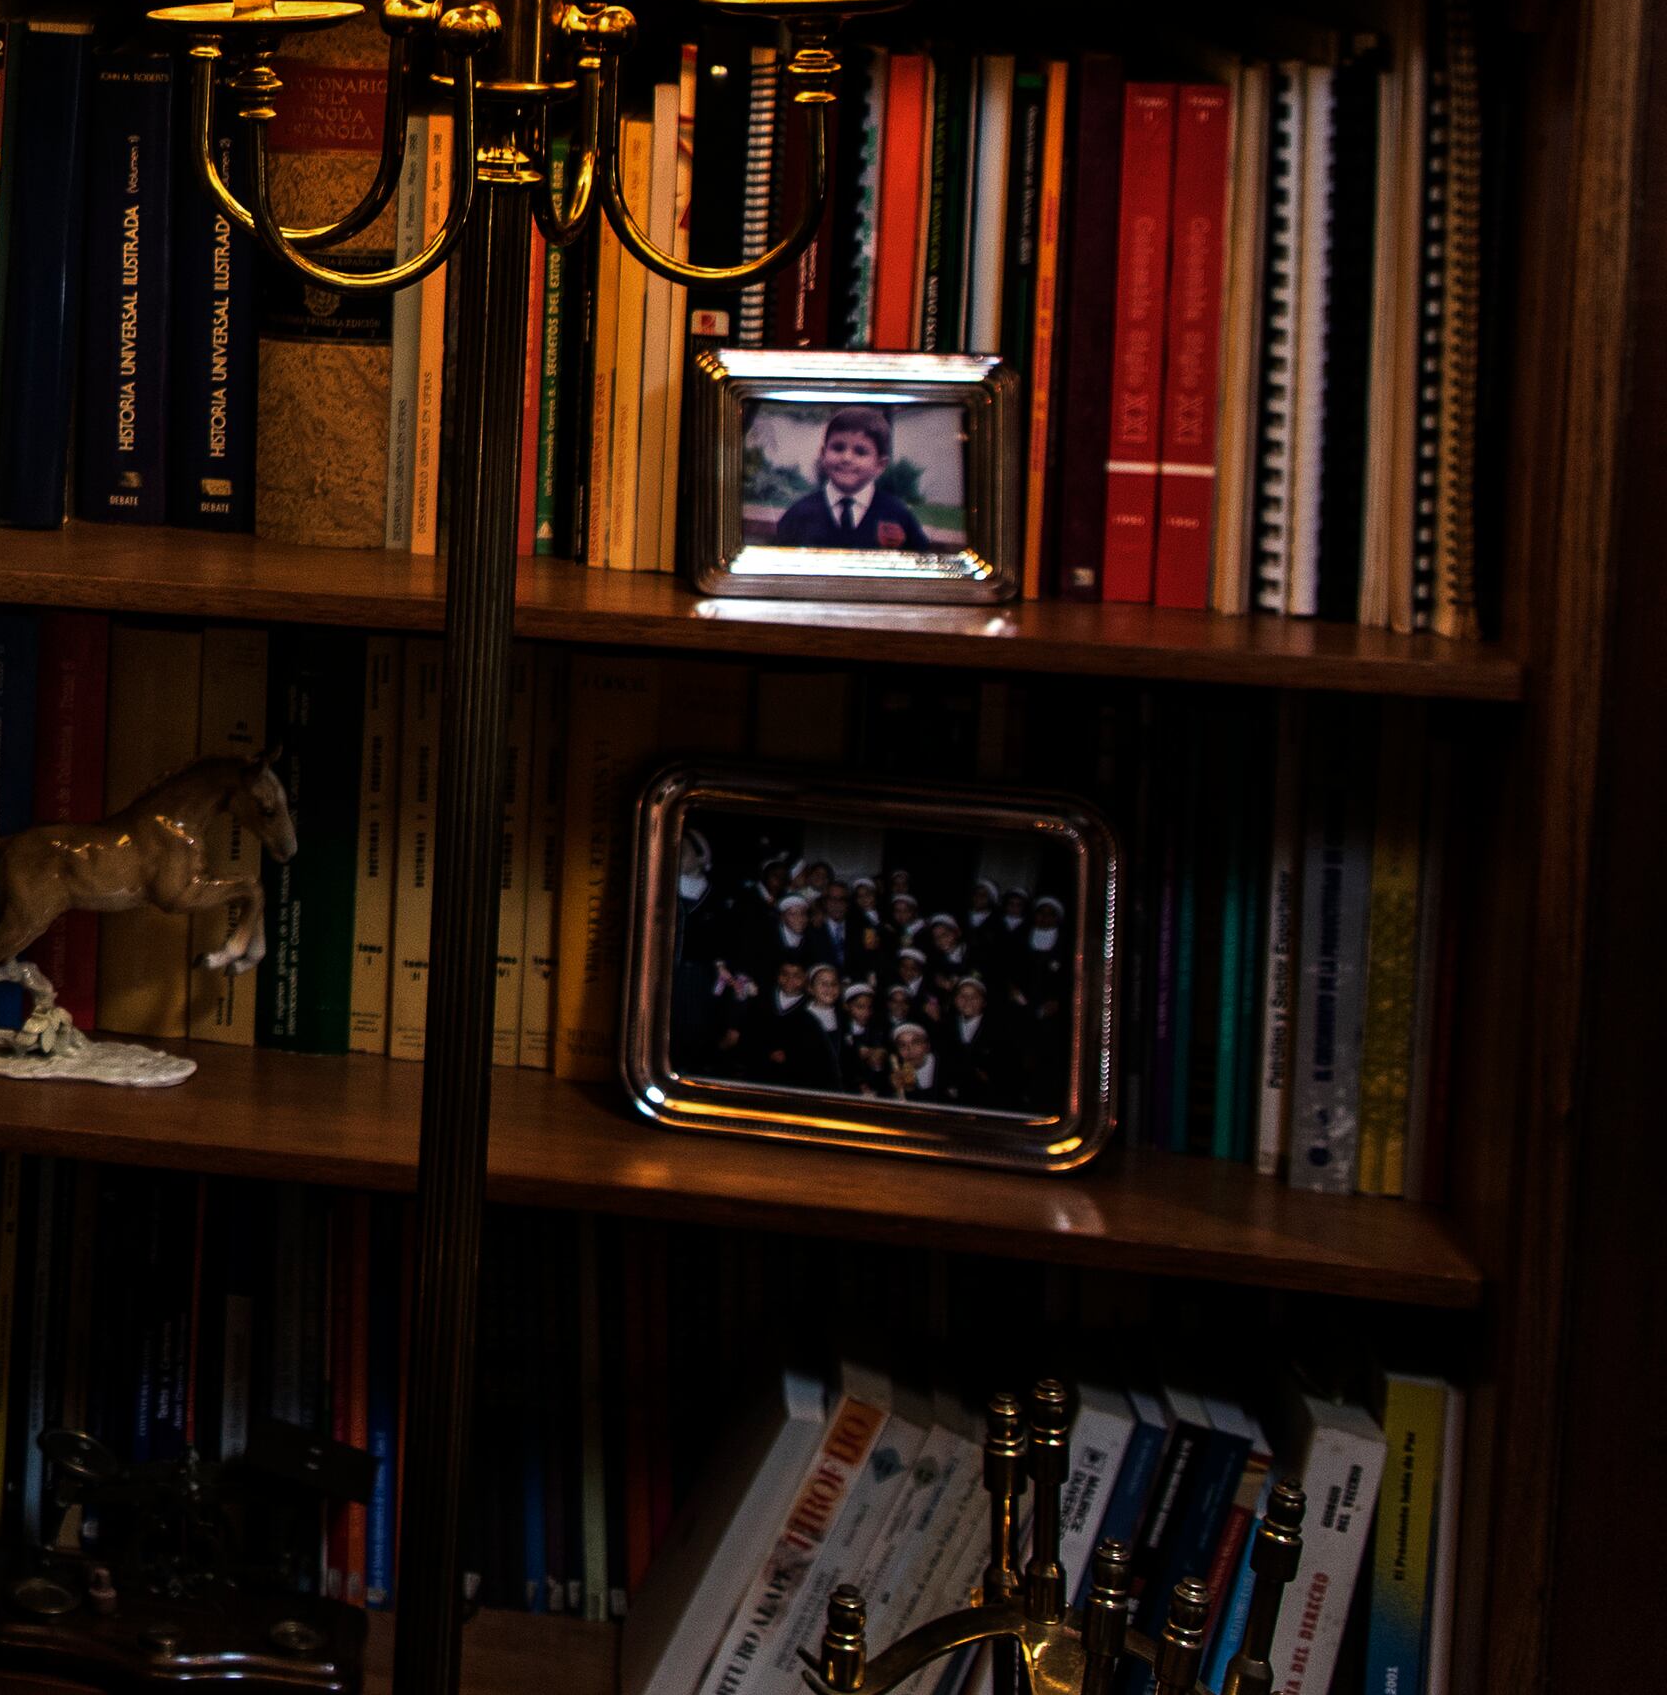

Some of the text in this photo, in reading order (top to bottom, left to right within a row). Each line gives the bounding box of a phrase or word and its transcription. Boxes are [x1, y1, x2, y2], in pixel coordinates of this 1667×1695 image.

[133, 73, 170, 82] ROBERTS
[118, 145, 140, 451] HISTORIA UNIVERSAL ILUSTRADA (Volumen
[547, 254, 562, 376] SECRETOS DEL EXITO
[1120, 215, 1156, 444] Colombia Siglo XXI
[1172, 216, 1212, 447] Colombia Siglo XXI
[209, 297, 230, 457] HISTORIA UNIVERSAL
[109, 495, 139, 506] DEBATE
[201, 502, 231, 513] DEBATE
[416, 370, 433, 534] DESARROLLO URBANO EN CIFRAS
[392, 485, 404, 542] DESARROLLO
[367, 822, 380, 877] DOCTRINAS
[414, 832, 427, 888] DOCTRINAS
[286, 900, 302, 1035] internacionales en Colombia
[1271, 870, 1292, 1008] Sector Exportador
[273, 1024, 284, 1035] El
[1335, 1465, 1363, 1533] DEL VECCHIO
[1392, 1431, 1416, 1581] El Presidente habla de Paz
[1289, 1572, 1329, 1674] DEL DERECHO
